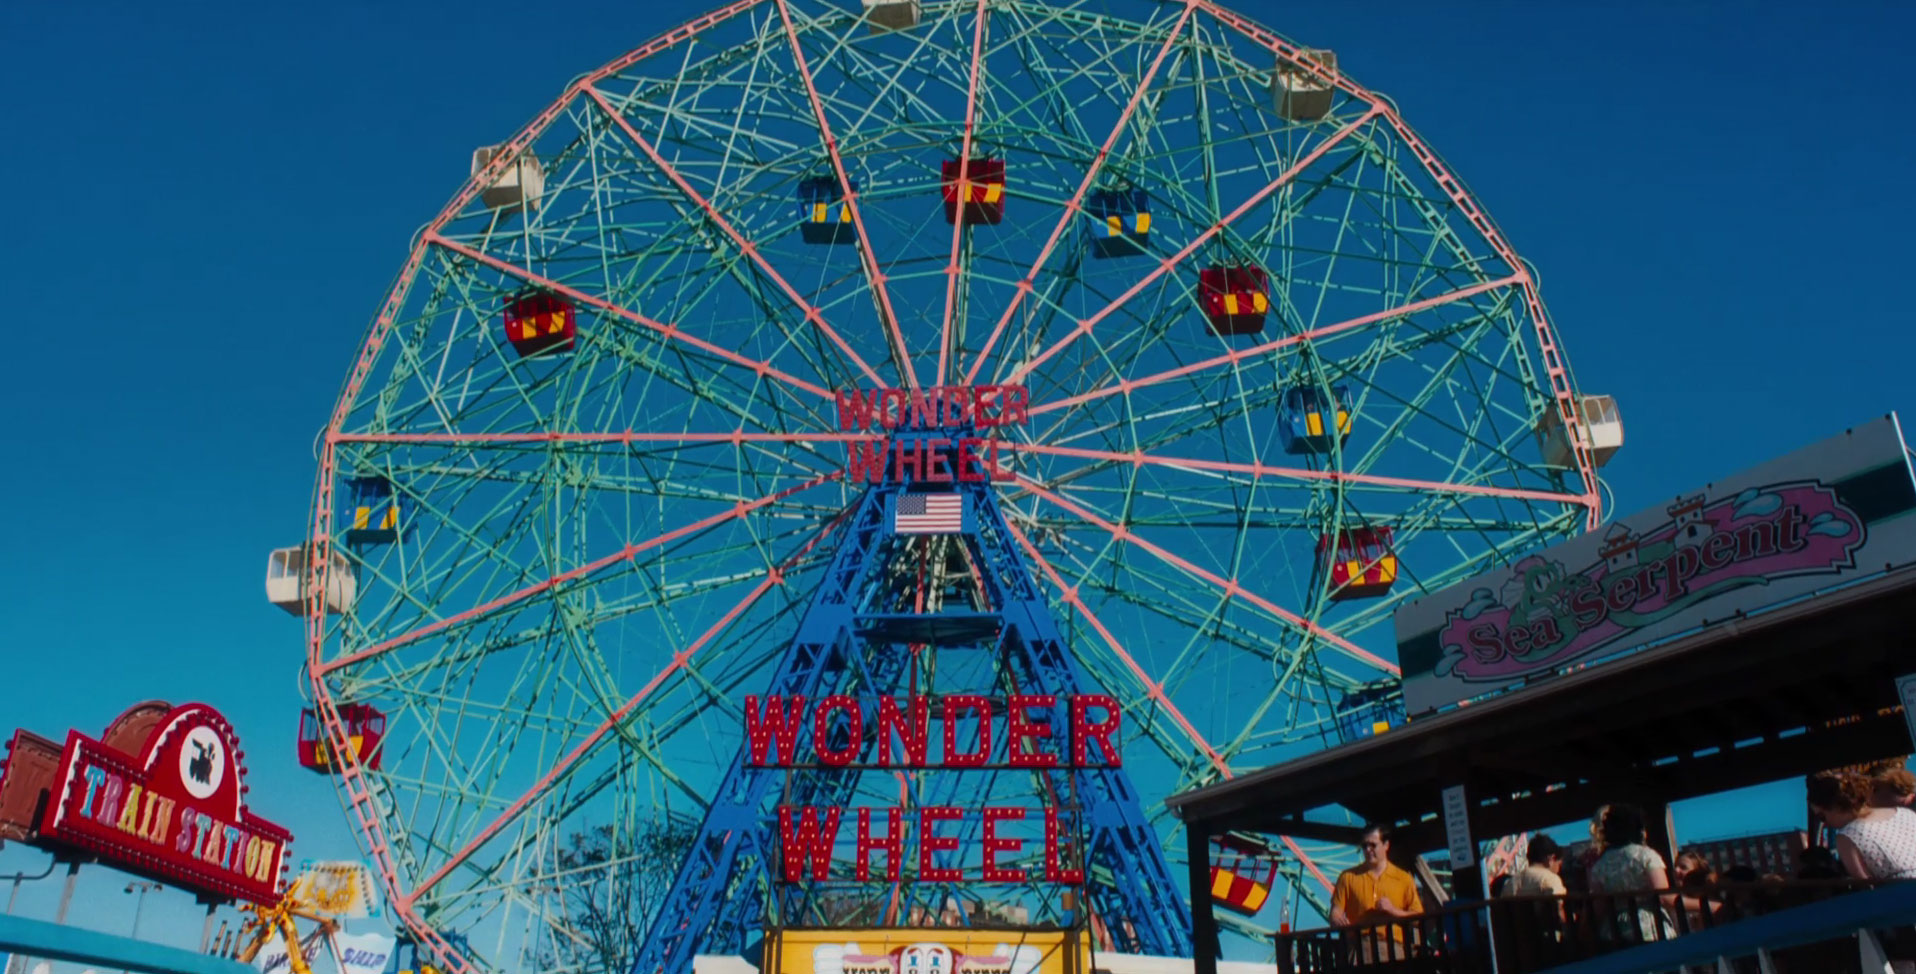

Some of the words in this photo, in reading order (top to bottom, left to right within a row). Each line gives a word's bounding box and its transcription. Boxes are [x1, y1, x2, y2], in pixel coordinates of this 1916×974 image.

[836, 384, 1028, 431] WONDER
[847, 436, 1017, 483] WHEEL
[1468, 617, 1562, 665] Sea
[1569, 504, 1809, 630] Serpent
[744, 694, 1122, 767] WONDER
[80, 764, 176, 845] TRAIN
[176, 807, 276, 882] STATION
[778, 805, 1085, 883] WHEEL
[343, 947, 387, 968] SHIP
